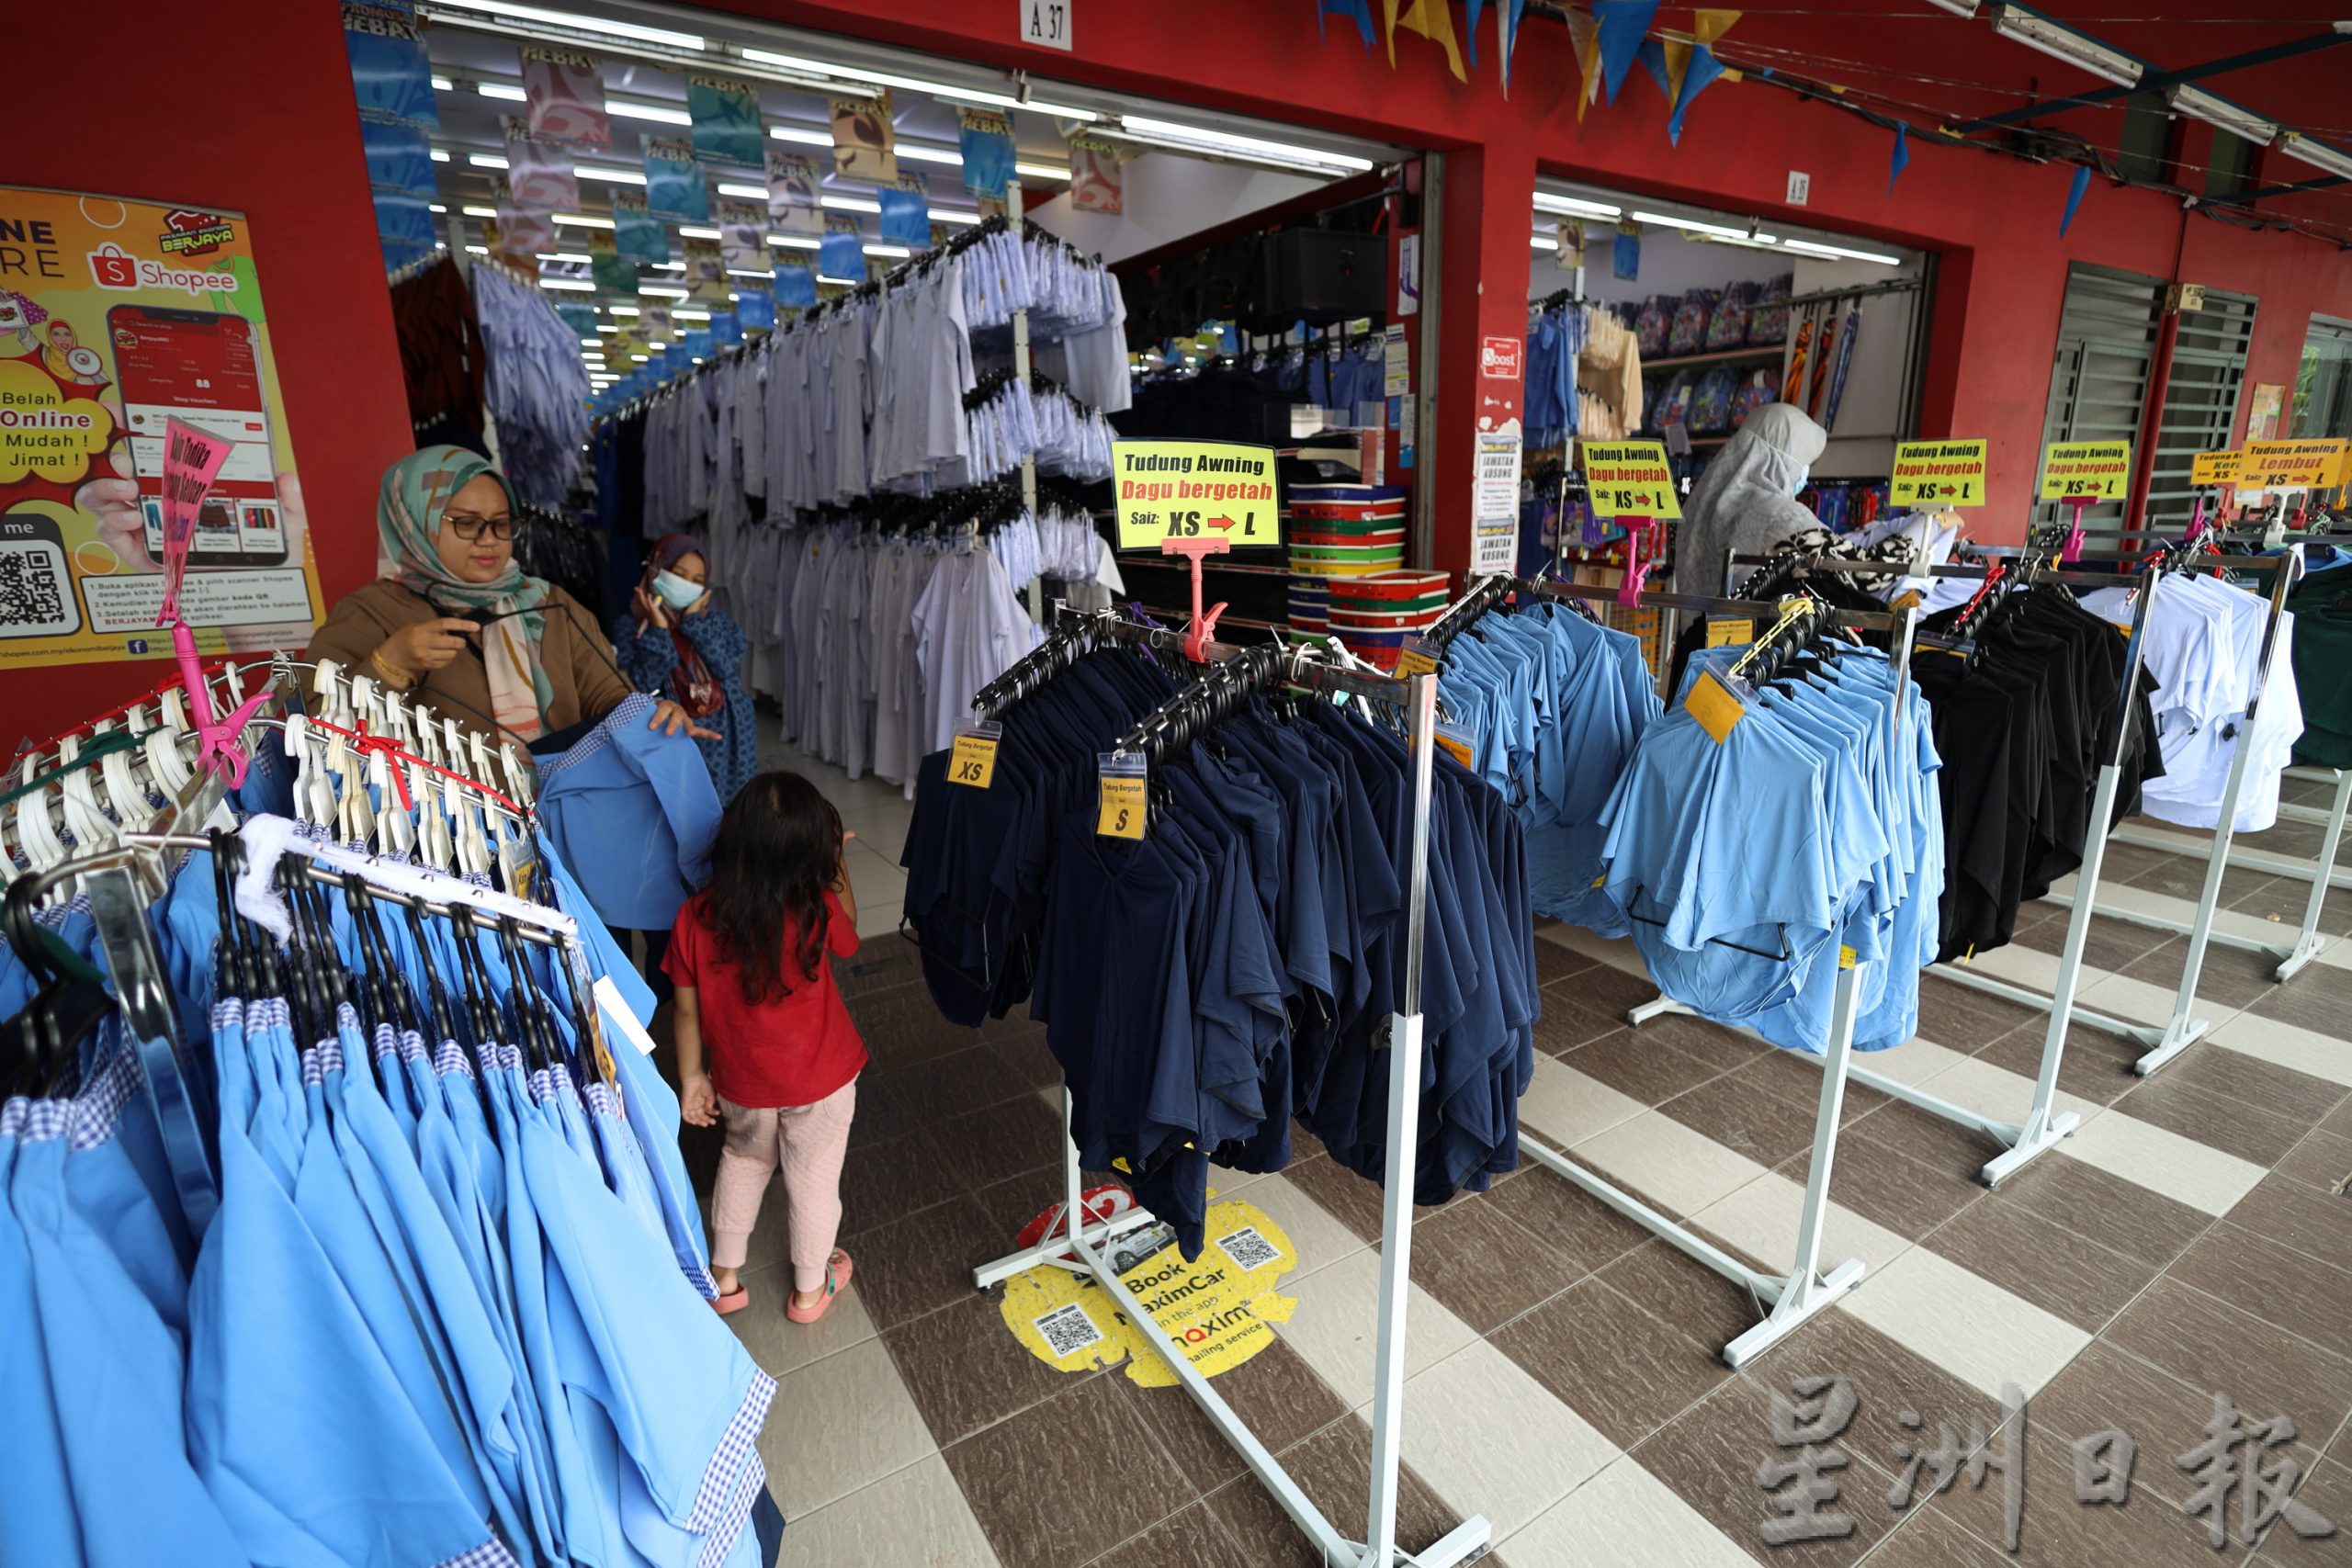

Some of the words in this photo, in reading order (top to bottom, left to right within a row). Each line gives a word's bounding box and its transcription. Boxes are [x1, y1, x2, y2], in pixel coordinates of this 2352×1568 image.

[1031, 1, 1042, 37] A
[1048, 4, 1063, 39] 37
[162, 230, 233, 252] BERJAYA
[141, 263, 234, 292] Shopee
[3, 392, 56, 404] Belah
[0, 410, 90, 427] Online
[6, 434, 74, 446] Mudah
[1589, 448, 1623, 462] Tudung
[1624, 447, 1659, 462] Awning
[1901, 446, 1938, 458] Tudung
[1939, 445, 1980, 457] Awning
[2052, 449, 2087, 459] Tudung
[2088, 447, 2123, 458] Awning
[2250, 446, 2291, 456] Tudung
[2294, 445, 2338, 455] Awning
[9, 453, 65, 466] Jimat
[1125, 454, 1192, 473] Tudung
[1196, 455, 1264, 476] Awning
[1482, 457, 1514, 467] JAWATAN
[2258, 457, 2324, 469] Lembut
[1484, 468, 1512, 479] KOSONG
[1589, 467, 1614, 482] Dagu
[1617, 467, 1668, 483] bergetah
[1895, 463, 1924, 477] Dagu
[1926, 461, 1982, 476] bergetah
[2047, 463, 2074, 474] Dagu
[2075, 462, 2126, 474] bergetah
[2213, 470, 2230, 479] XS
[2265, 474, 2288, 486] XS
[2315, 472, 2324, 484] L
[1122, 480, 1172, 501] Dagu
[1178, 480, 1272, 501] bergetah
[1916, 482, 1937, 499] XS
[1962, 482, 1970, 499] L
[2065, 479, 2084, 494] XS
[2106, 479, 2113, 494] L
[1614, 491, 1633, 509] XS
[1656, 491, 1664, 509] L
[4, 523, 34, 534] me
[1130, 512, 1159, 525] Saiz:
[1167, 511, 1201, 536] XS
[1244, 512, 1256, 536] L
[1479, 538, 1511, 550] JAWATAN
[1481, 549, 1510, 561] KOSONG
[105, 616, 156, 626] BERJAYAM
[956, 761, 983, 781] XS
[1115, 808, 1128, 831] S
[1125, 1263, 1186, 1294] Book
[1171, 1308, 1194, 1322] the
[1226, 1322, 1263, 1346] service
